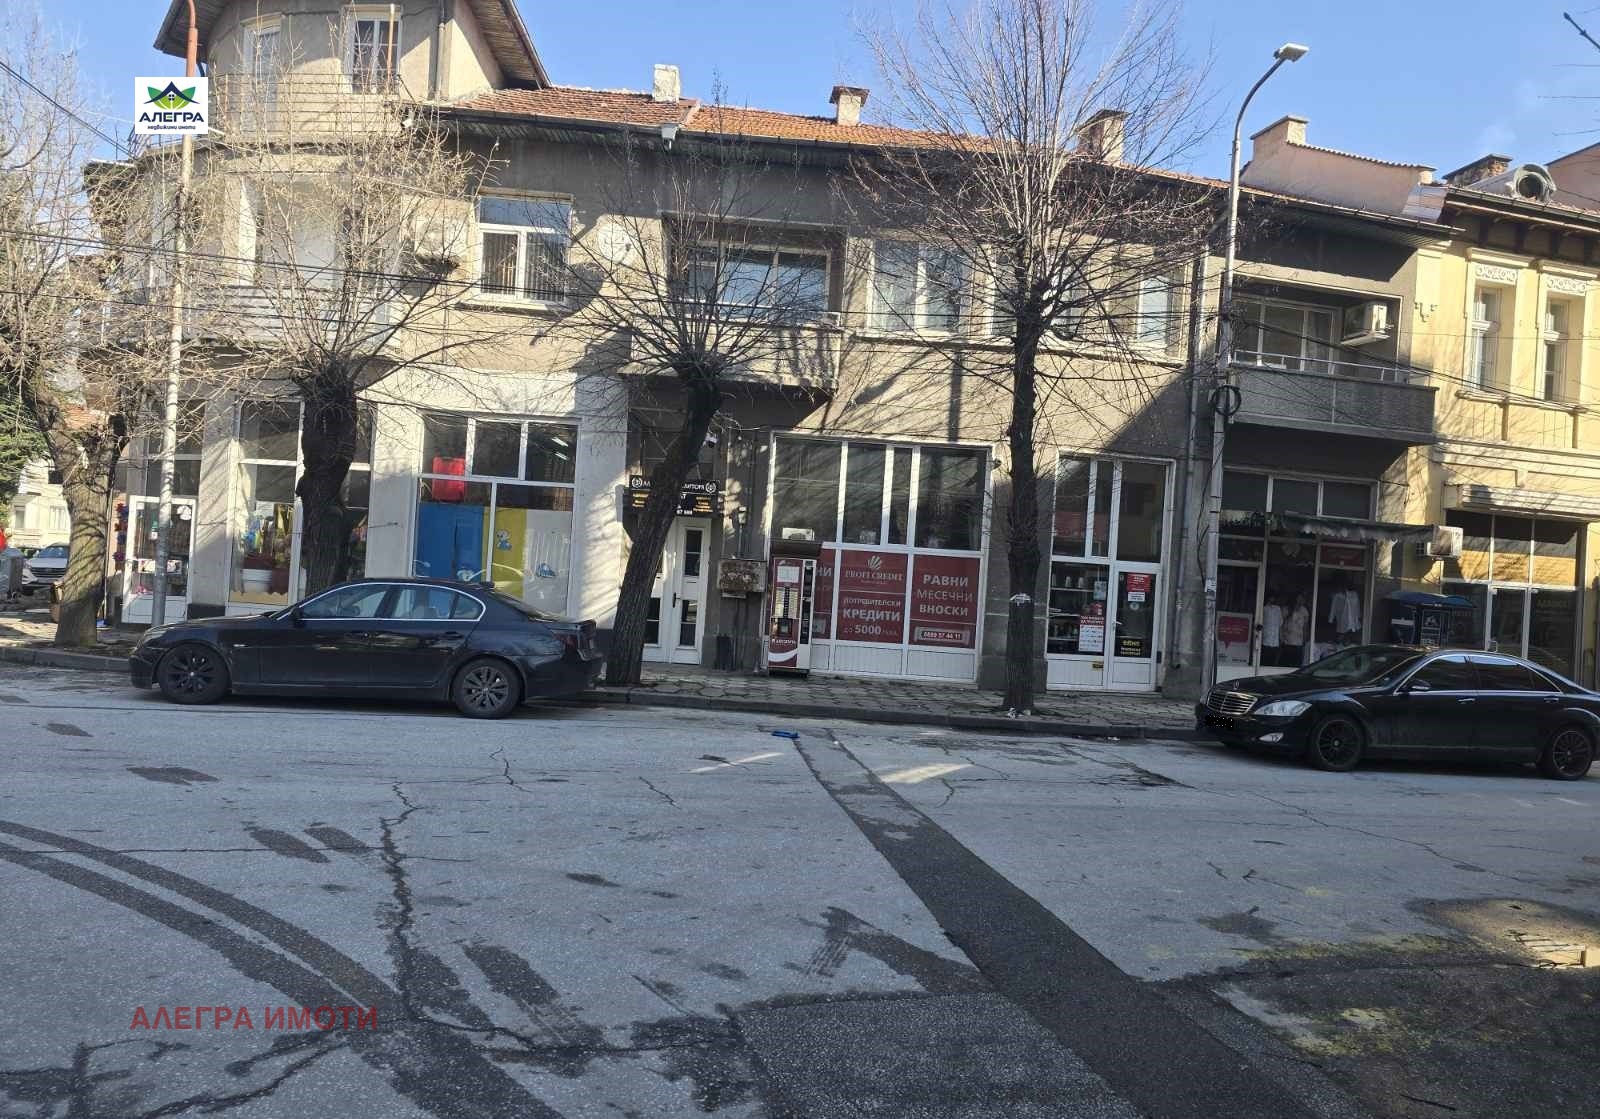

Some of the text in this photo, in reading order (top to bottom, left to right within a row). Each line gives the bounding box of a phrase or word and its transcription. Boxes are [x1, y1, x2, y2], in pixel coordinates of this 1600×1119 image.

[923, 574, 969, 587] РАВНИ
[916, 588, 973, 602] МЕСЕЧНИ
[842, 608, 901, 622] КРЕДИТИ
[919, 604, 969, 617] ВНОСКИ
[854, 624, 882, 635] 5000
